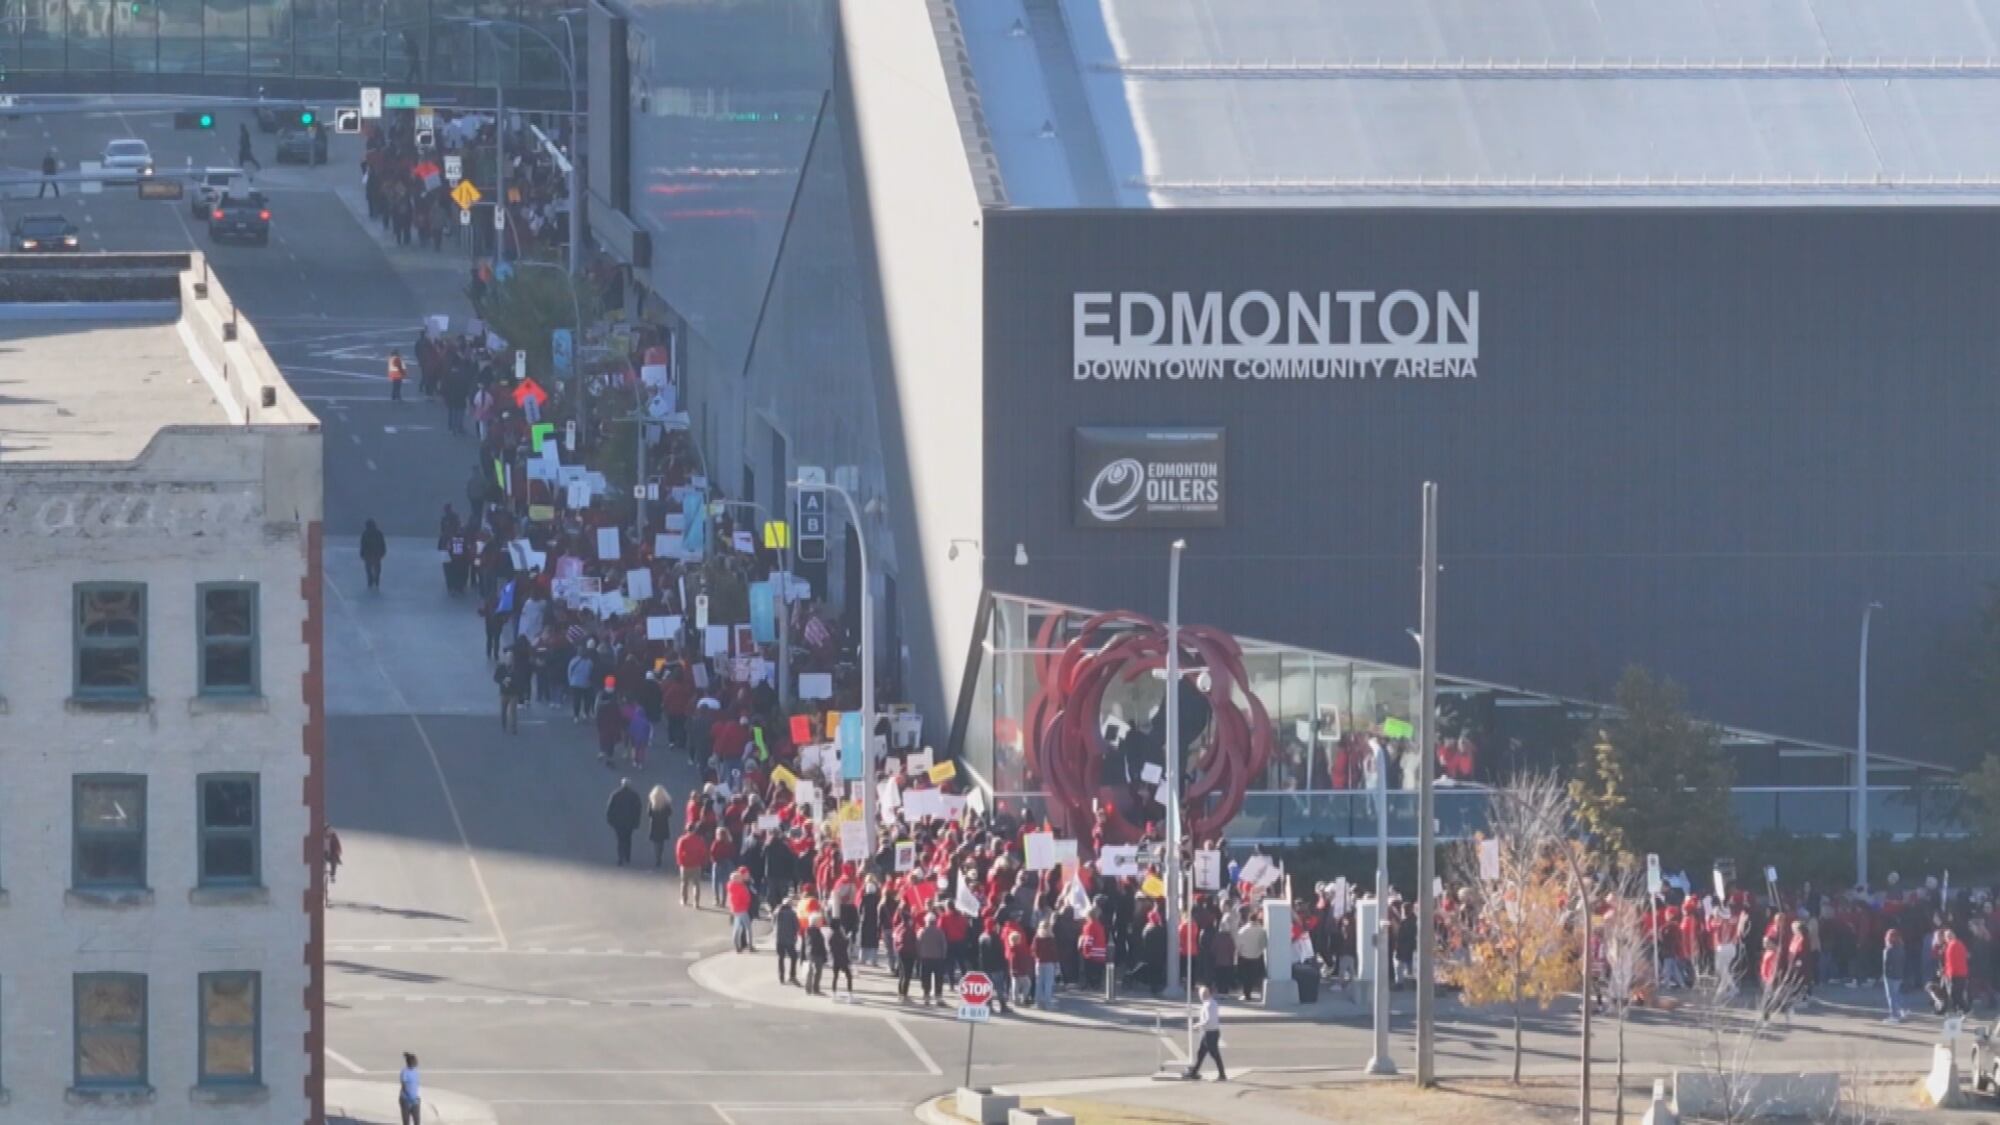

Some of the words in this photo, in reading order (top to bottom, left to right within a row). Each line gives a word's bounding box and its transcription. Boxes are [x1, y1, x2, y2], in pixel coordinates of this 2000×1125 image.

[1073, 289, 1479, 353] EDMONTON
[1073, 358, 1224, 380] DOWNTOWN
[1233, 358, 1387, 380] COMMUNITY
[1393, 357, 1477, 379] ARENA
[1148, 462, 1217, 477] EDMONTON
[1146, 479, 1218, 502] OILERS
[807, 495, 819, 510] A
[808, 518, 819, 532] B
[962, 982, 991, 995] STOP
